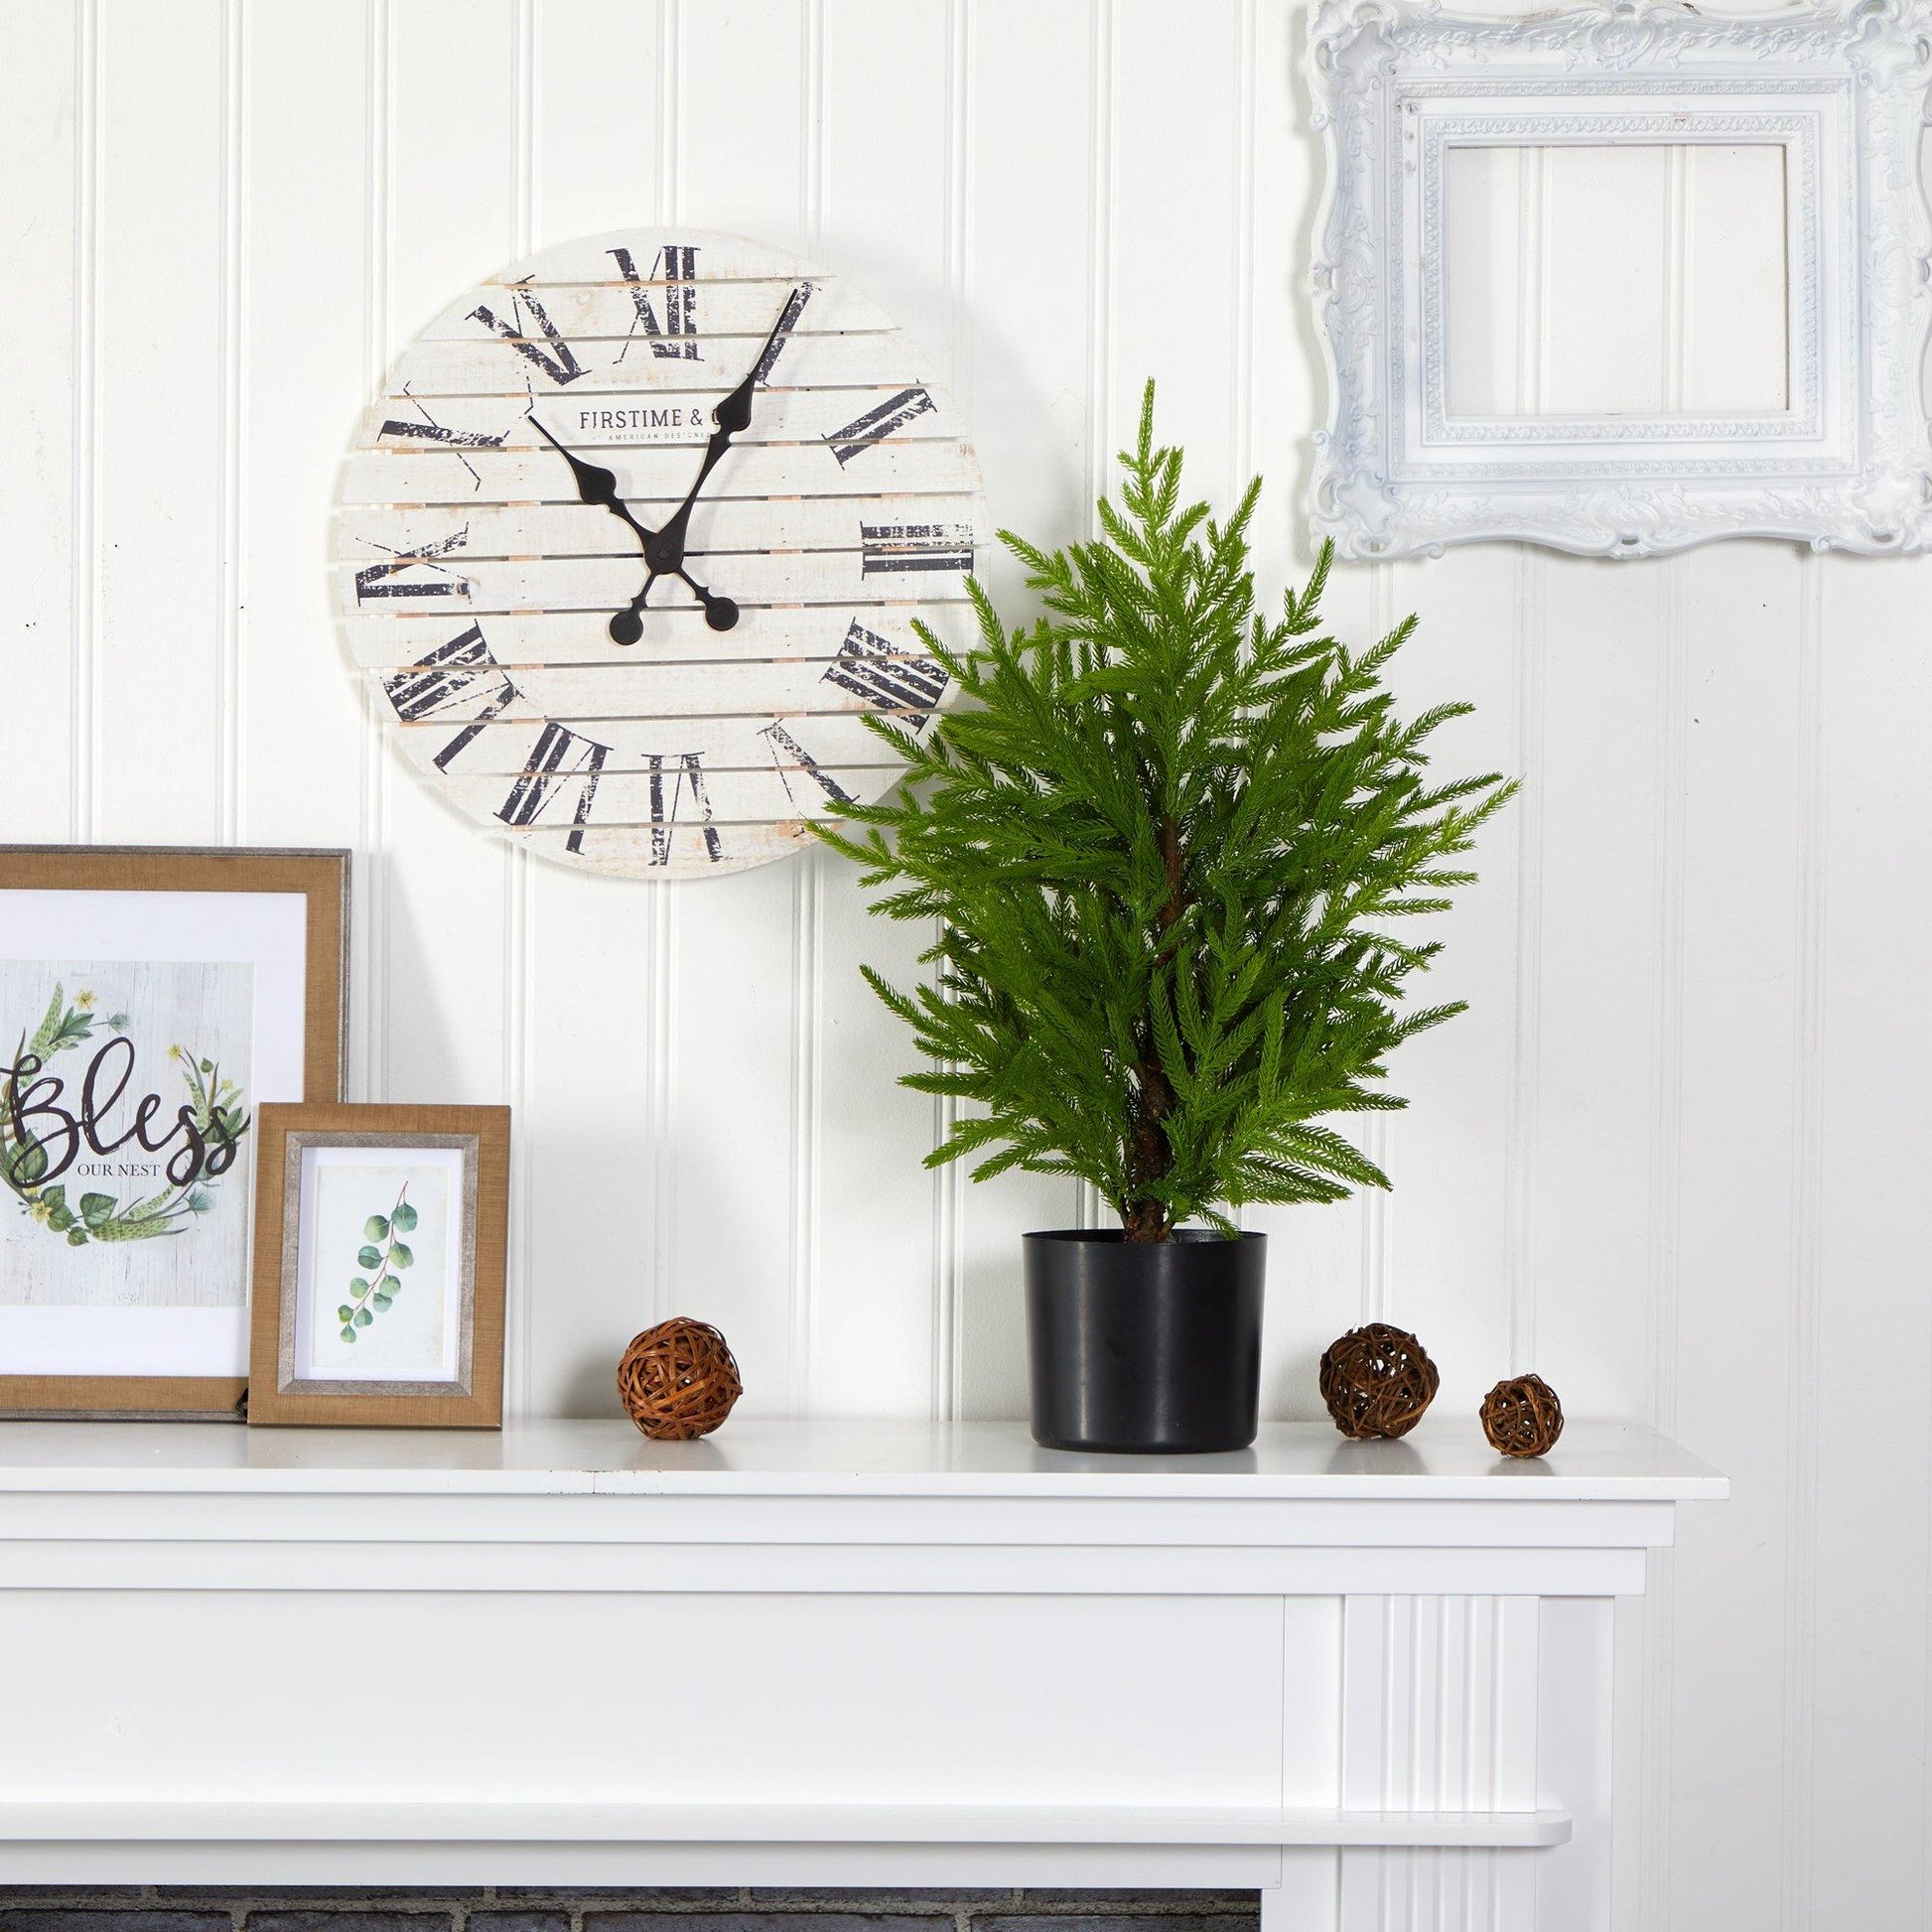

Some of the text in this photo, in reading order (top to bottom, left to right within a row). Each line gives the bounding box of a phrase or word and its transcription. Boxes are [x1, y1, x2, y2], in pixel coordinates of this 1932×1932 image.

[580, 409, 682, 429] FIRSTIME
[690, 409, 703, 426] &
[608, 431, 659, 441] AMERICAN
[0, 1036, 251, 1187] Bless
[77, 1163, 161, 1177] OUR NEST
